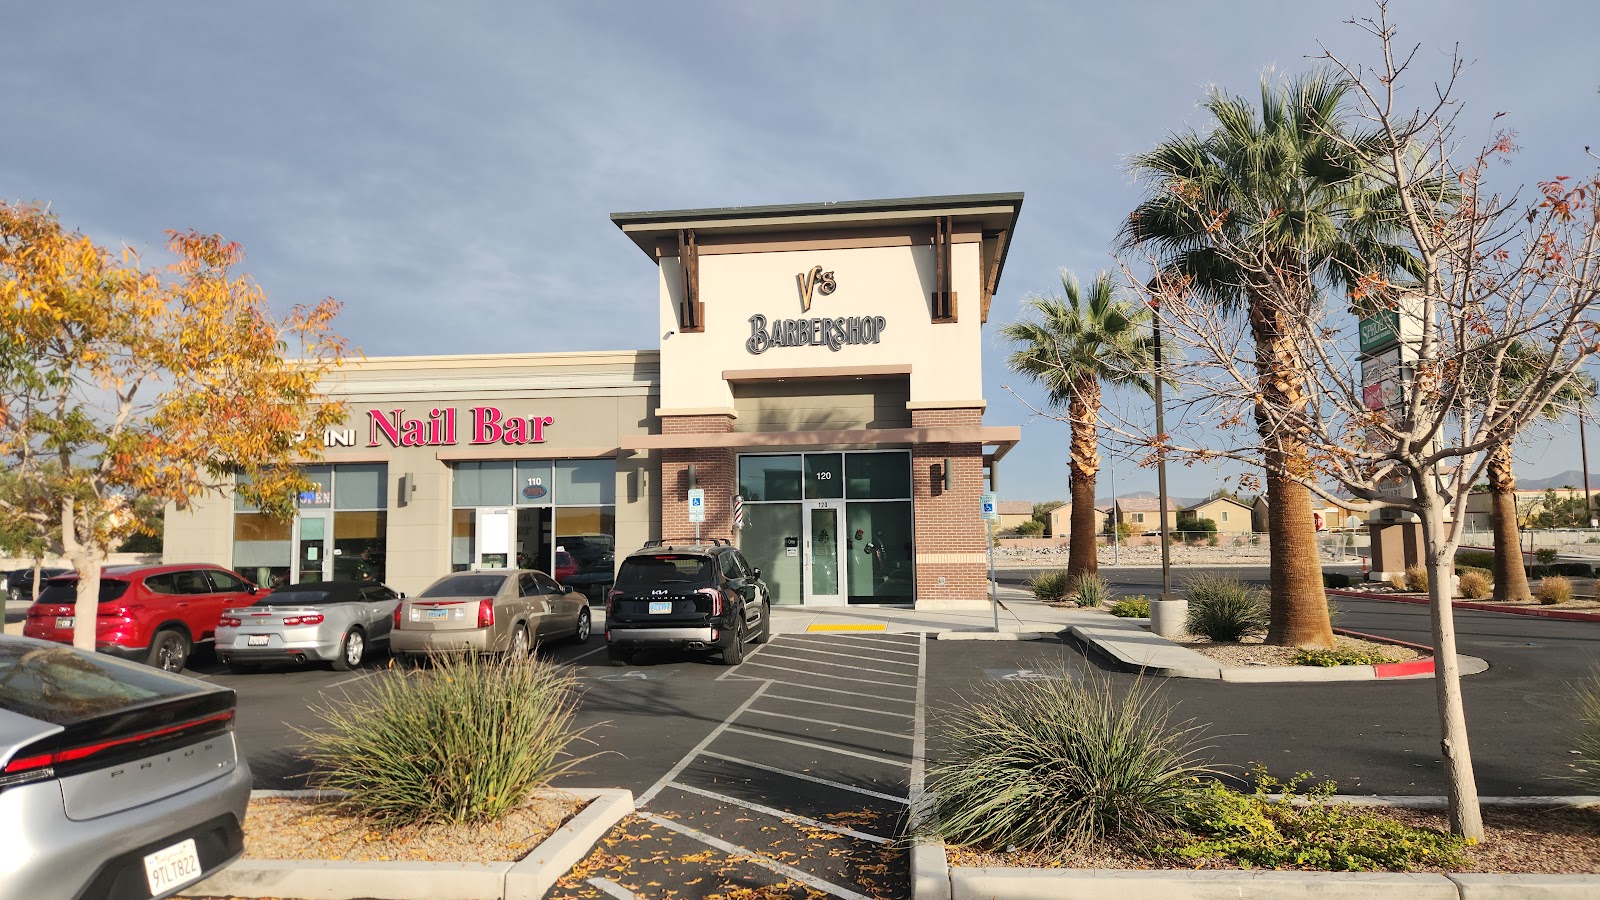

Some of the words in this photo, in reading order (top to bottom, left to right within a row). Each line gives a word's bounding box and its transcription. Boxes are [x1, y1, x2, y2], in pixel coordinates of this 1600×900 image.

[796, 265, 837, 313] V's
[746, 313, 887, 354] BARBERSHOP
[366, 407, 458, 447] Nail
[469, 406, 554, 446] Bar
[527, 477, 542, 486] 110
[816, 472, 832, 480] 120
[300, 491, 331, 504] OPEN
[110, 744, 213, 778] PRIUS
[152, 854, 197, 889] 9TLT822
